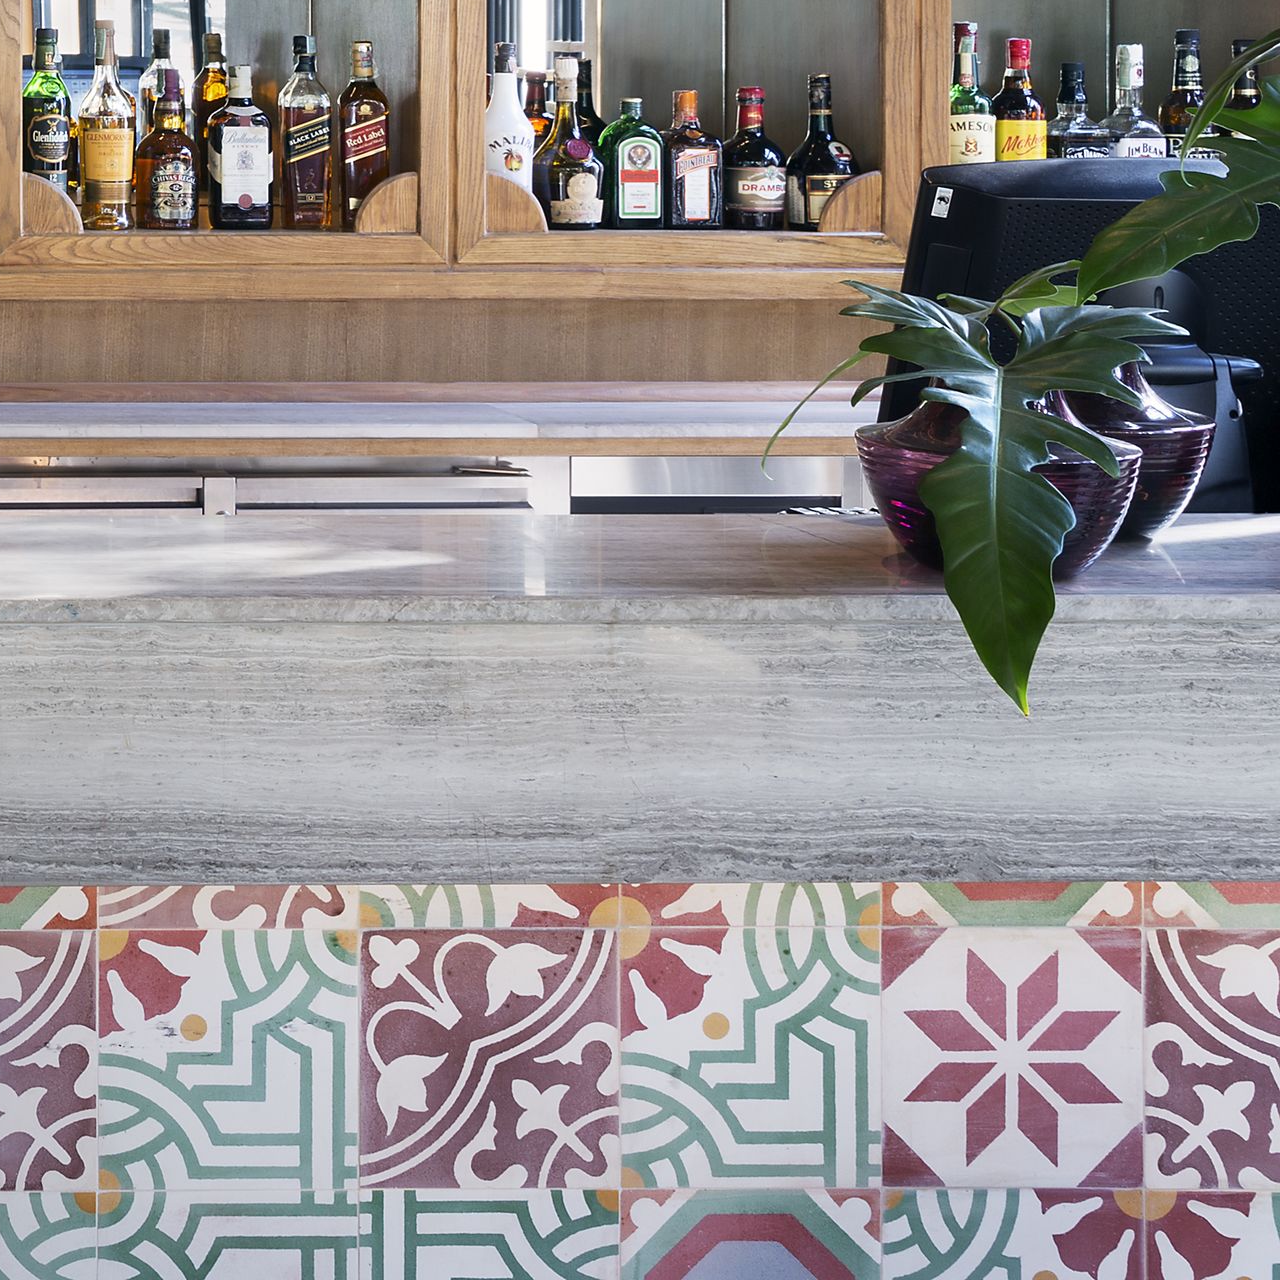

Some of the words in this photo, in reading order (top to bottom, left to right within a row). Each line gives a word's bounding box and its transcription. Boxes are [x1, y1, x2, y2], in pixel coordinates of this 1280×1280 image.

[32, 130, 69, 143] Glenfiddich
[289, 134, 309, 146] BLACK
[310, 126, 330, 139] LABEL
[345, 137, 363, 148] Red
[364, 127, 385, 143] Label
[1125, 146, 1141, 158] JIM
[1142, 143, 1164, 158] BEAM
[49, 173, 58, 183] 12
[151, 174, 177, 185] CHIVAS
[178, 174, 197, 185] REGAL
